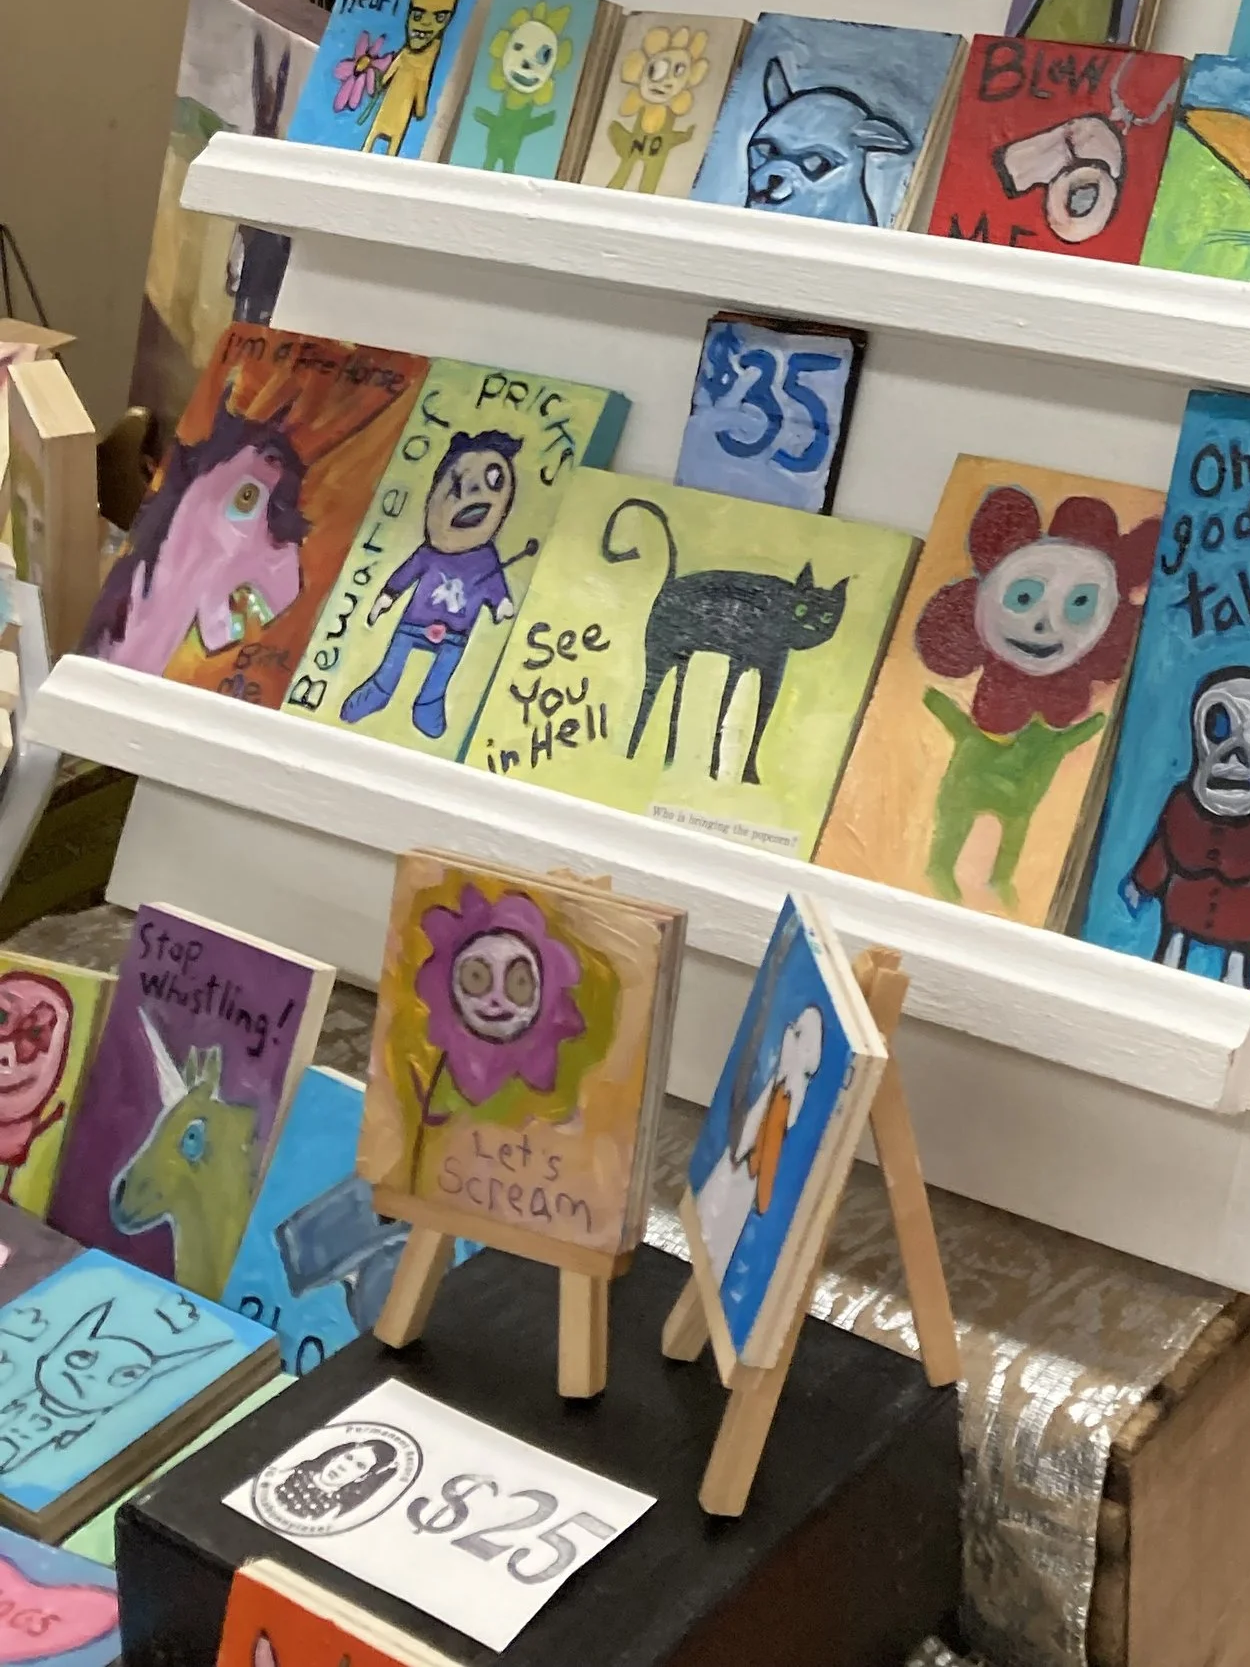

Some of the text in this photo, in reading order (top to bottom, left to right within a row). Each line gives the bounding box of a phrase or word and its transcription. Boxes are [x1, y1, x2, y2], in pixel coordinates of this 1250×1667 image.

[628, 134, 663, 158] NO
[222, 333, 266, 364] I'm
[701, 322, 843, 474] $35
[288, 488, 409, 712] Beware
[402, 389, 450, 462] of
[523, 621, 612, 671] See
[510, 676, 590, 726] You
[486, 702, 608, 774] in Hell
[653, 805, 799, 848] Who is bringing the popcorn?
[139, 922, 203, 976] Stop
[472, 1131, 563, 1182] Let's
[438, 1156, 594, 1234] Scream
[406, 1473, 618, 1585] $25
